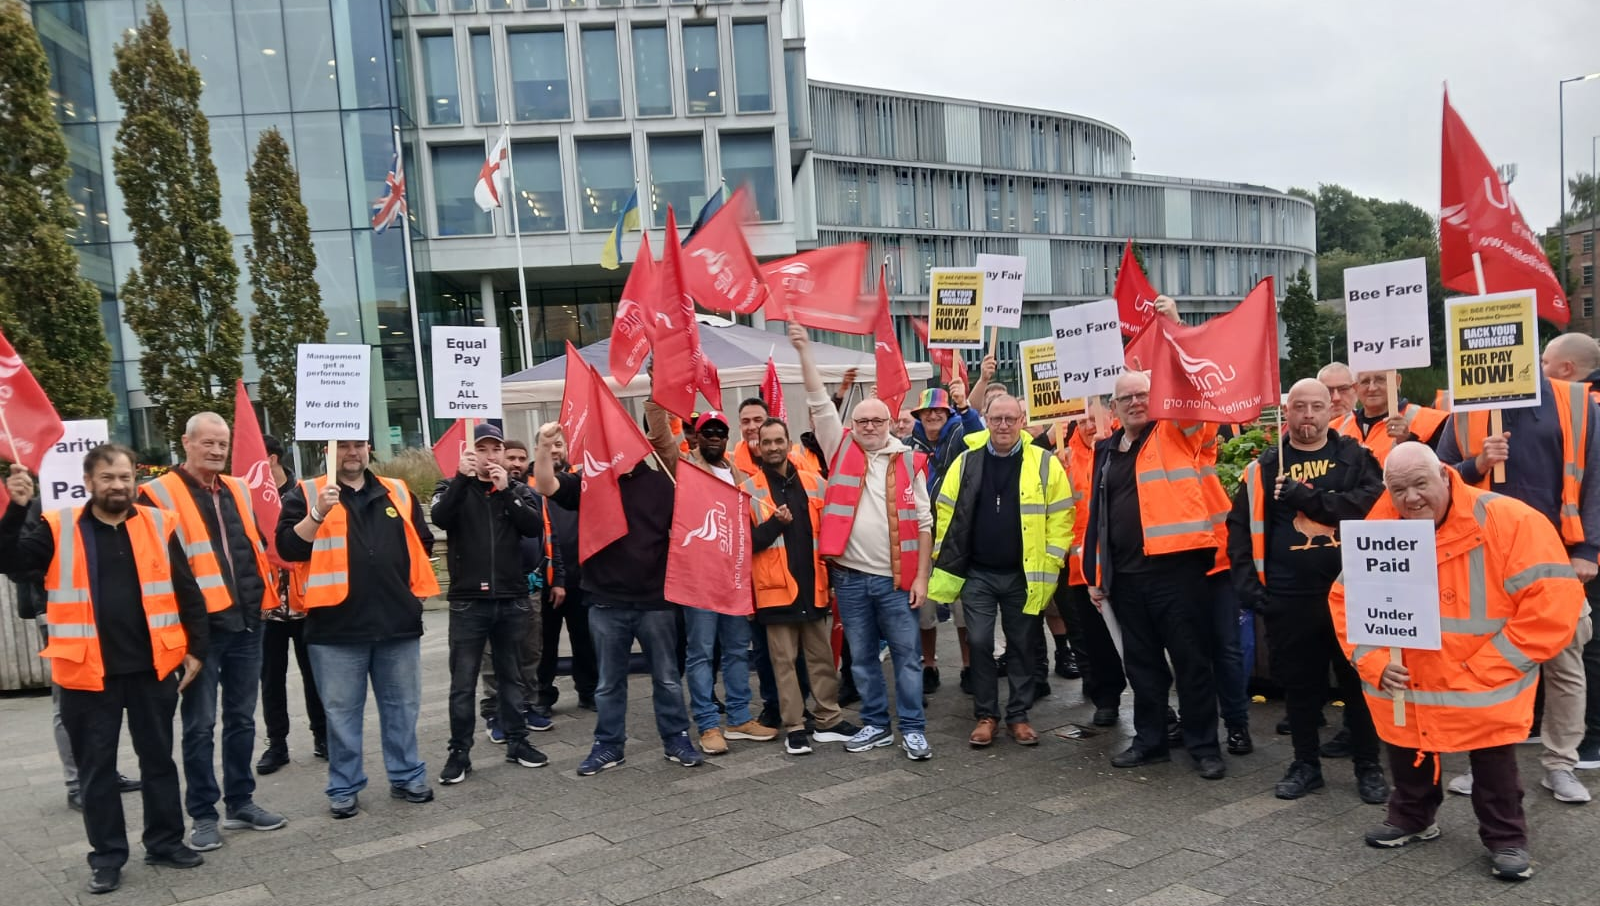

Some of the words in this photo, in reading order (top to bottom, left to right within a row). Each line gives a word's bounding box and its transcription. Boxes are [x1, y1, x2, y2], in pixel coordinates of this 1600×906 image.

[986, 271, 998, 281] ay
[1001, 270, 1022, 280] Fair
[1349, 289, 1380, 302] Bee
[1385, 283, 1423, 297] Fare
[936, 308, 954, 317] FAIR
[954, 308, 969, 317] PAY
[996, 305, 1020, 315] Fare
[935, 317, 968, 331] NOW!
[1056, 327, 1083, 339] Bee
[1086, 320, 1117, 334] Fare
[1463, 326, 1490, 340] BACK
[1490, 324, 1517, 336] YOUR
[446, 338, 487, 351] Equal
[1353, 340, 1384, 354] Pay
[1390, 335, 1424, 349] Fair
[1468, 335, 1516, 349] WORKERS
[306, 353, 361, 361] Management
[454, 353, 480, 367] Pay
[1460, 352, 1488, 367] FAIR
[1490, 350, 1513, 364] PAY
[306, 370, 361, 378] performance
[1037, 369, 1058, 380] WORK
[1063, 371, 1090, 383] Pay
[1094, 364, 1122, 378] Fair
[1460, 363, 1514, 386] NOW!
[457, 390, 479, 398] ALL
[1033, 382, 1053, 393] FAIR
[449, 401, 488, 410] Drivers
[304, 421, 361, 430] Performing
[56, 438, 105, 453] arity
[52, 481, 87, 500] Pa
[1356, 536, 1418, 551] Under
[1365, 557, 1410, 573] Paid
[1367, 607, 1414, 621] Under
[1364, 623, 1418, 638] Valued
